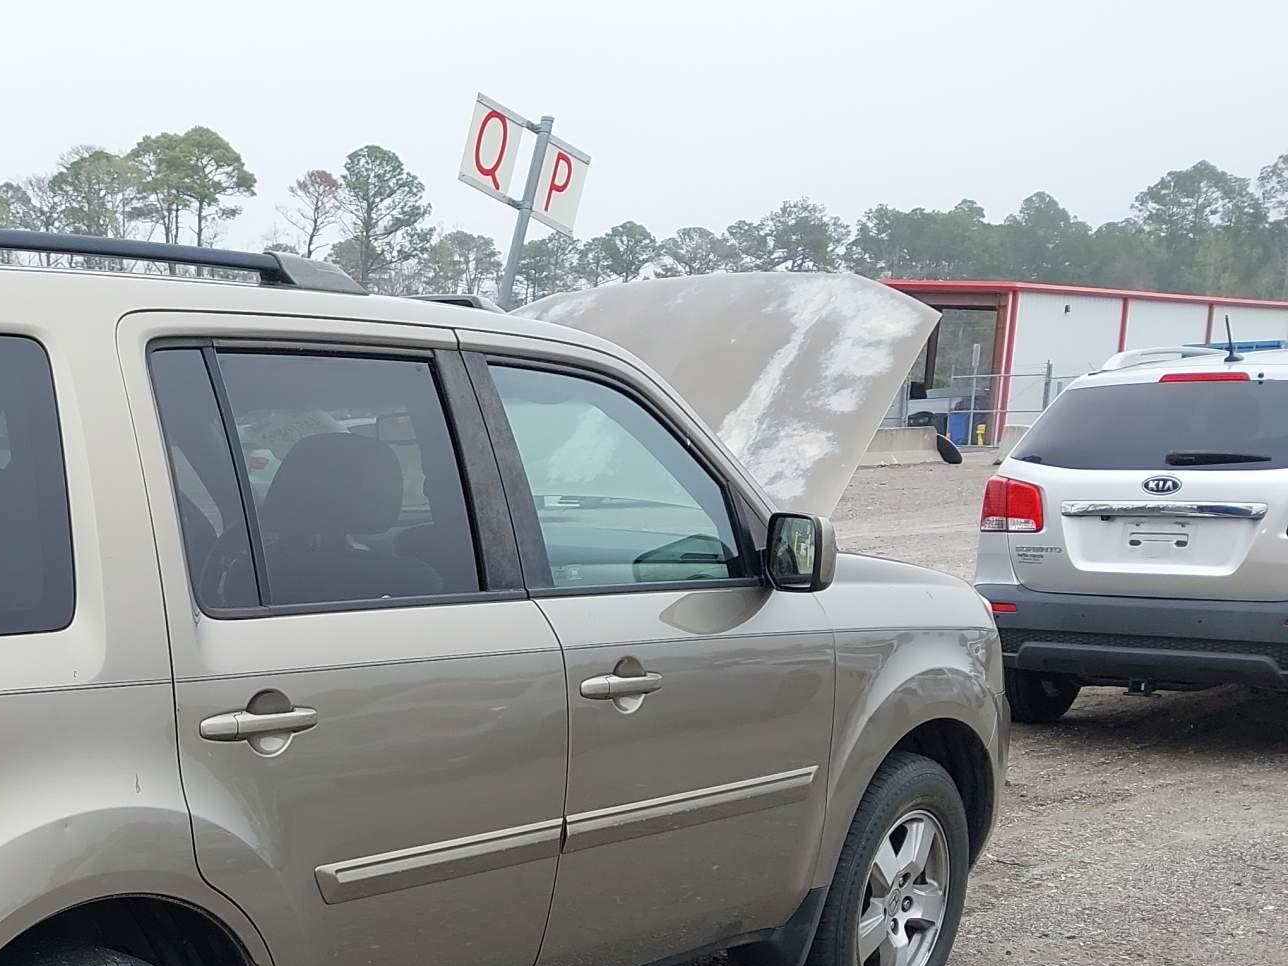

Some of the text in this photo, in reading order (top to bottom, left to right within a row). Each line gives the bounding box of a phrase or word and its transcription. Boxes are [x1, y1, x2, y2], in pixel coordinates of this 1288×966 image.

[475, 110, 508, 191] Q
[544, 151, 572, 212] P
[1148, 480, 1174, 491] KIA
